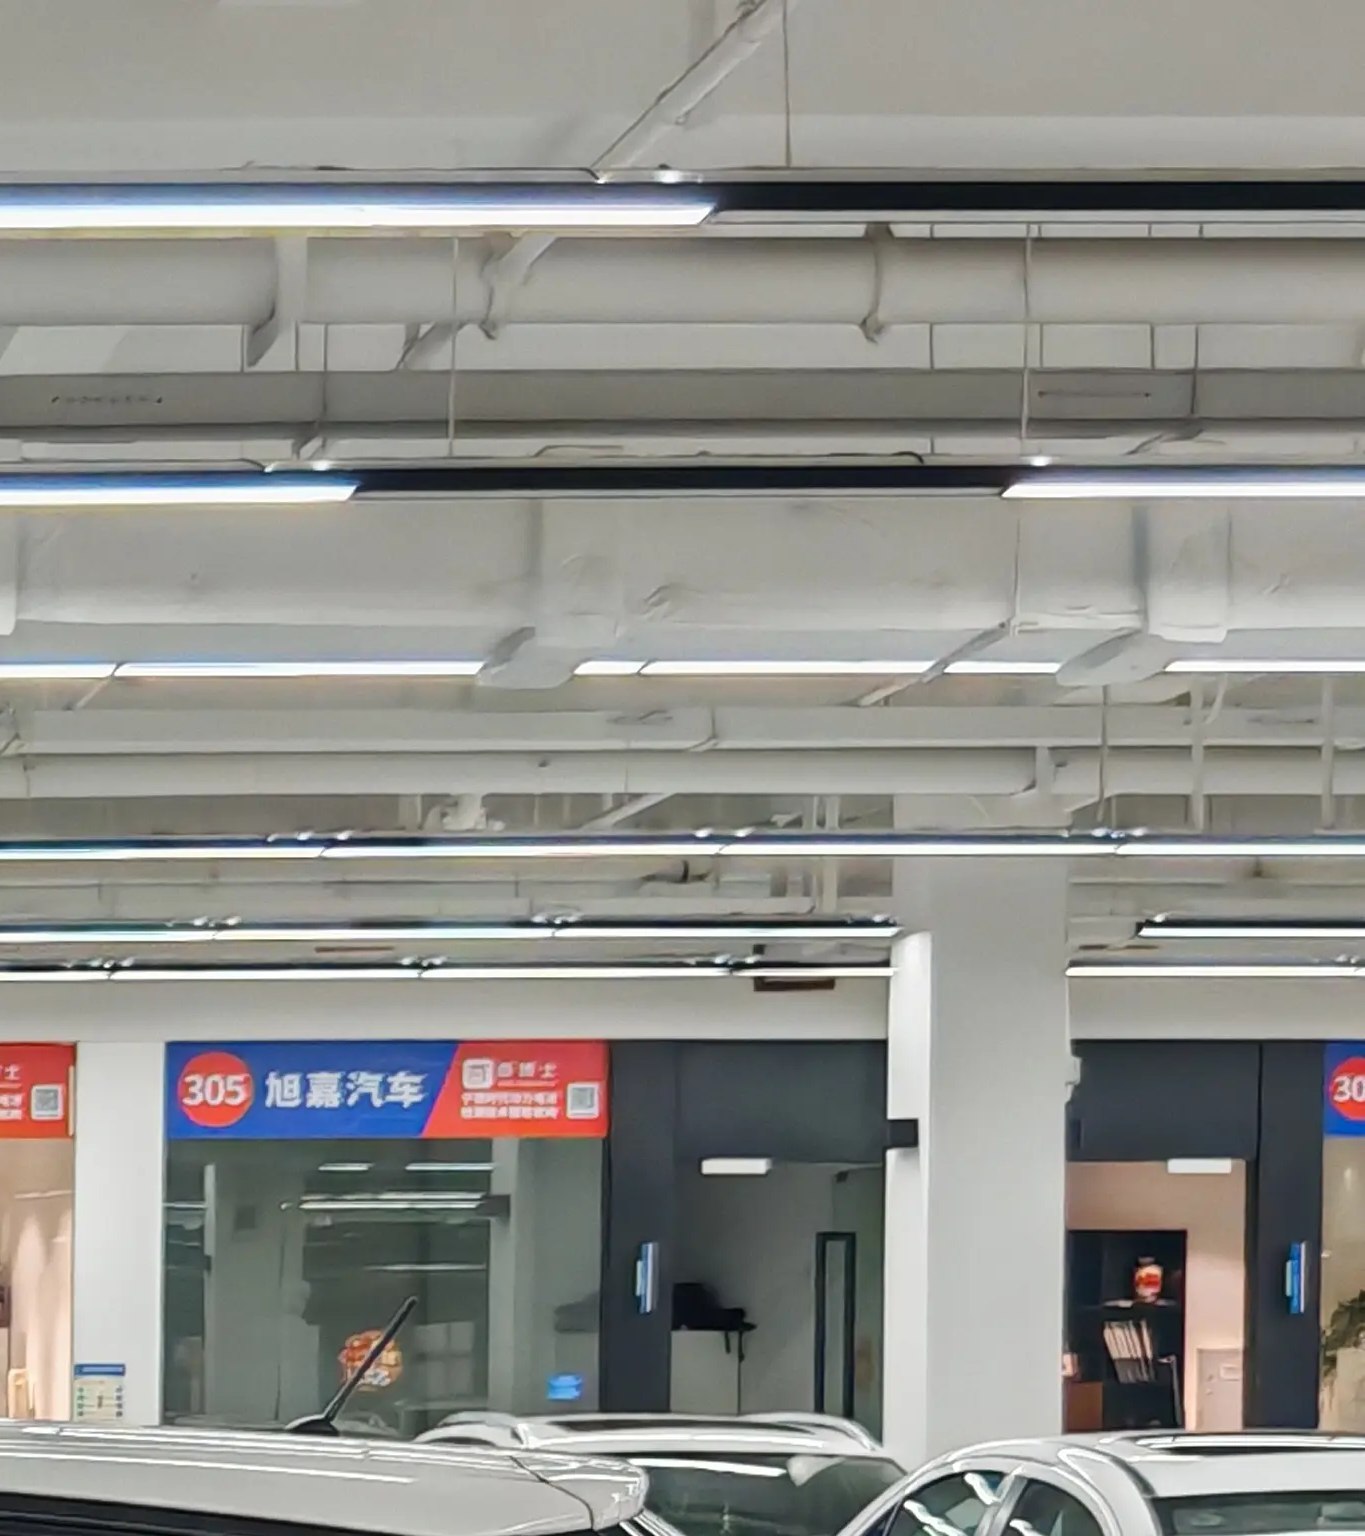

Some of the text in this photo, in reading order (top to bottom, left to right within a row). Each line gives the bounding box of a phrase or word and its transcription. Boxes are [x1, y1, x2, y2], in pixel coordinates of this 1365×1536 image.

[182, 1071, 429, 1109] 305 旭嘉汽车
